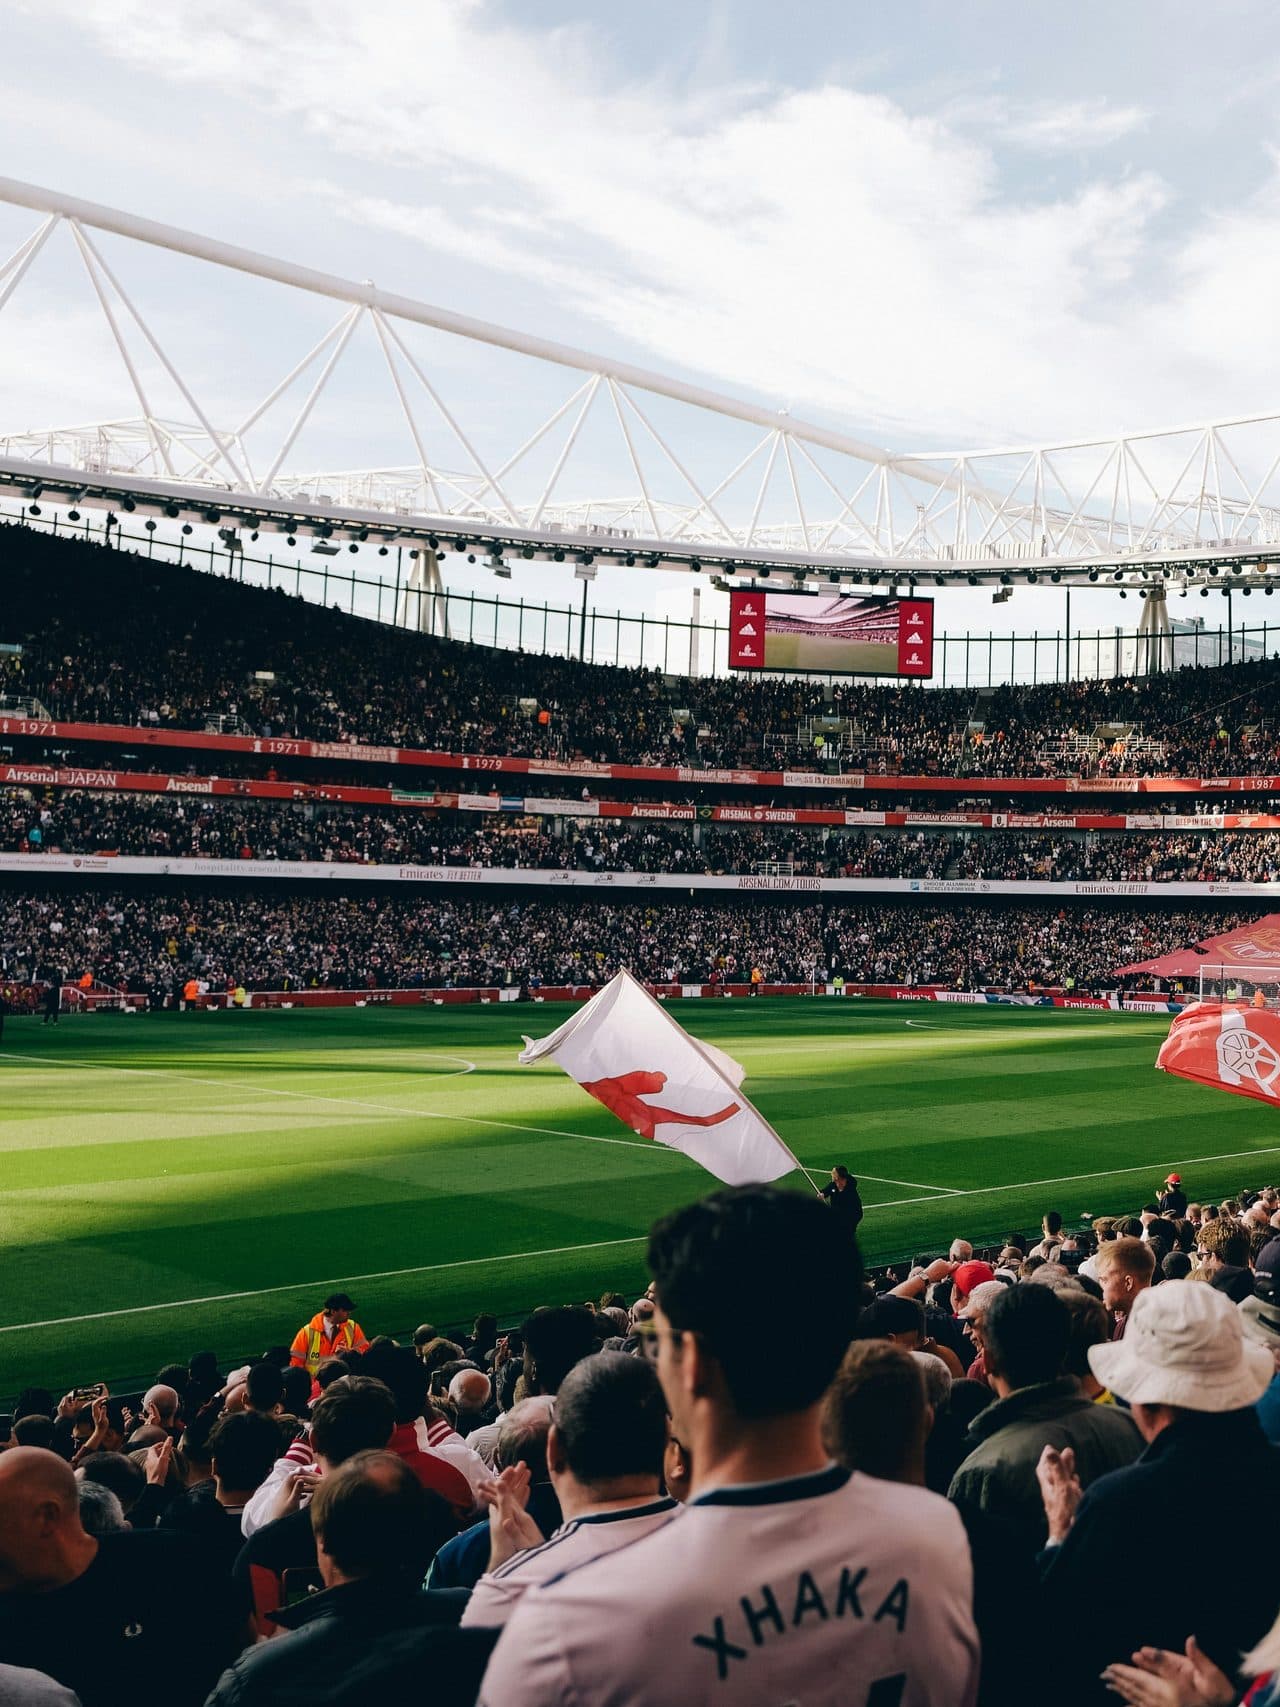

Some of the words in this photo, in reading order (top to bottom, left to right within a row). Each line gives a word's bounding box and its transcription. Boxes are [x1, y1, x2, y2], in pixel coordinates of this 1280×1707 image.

[20, 722, 57, 736] 1971
[268, 742, 300, 754] 1971
[475, 759, 502, 770] 1979
[6, 768, 59, 783] Arsenal
[67, 772, 117, 787] JAPAN
[166, 779, 213, 793] Arsenal
[1251, 780, 1274, 789] 1987
[631, 806, 694, 819] Arsenal.com
[719, 808, 752, 820] ARSENAL
[765, 810, 796, 821] SWEDEN
[1042, 816, 1076, 827] Arsenal
[399, 868, 444, 880] Emirates
[738, 877, 820, 889] ARSENAL.COM/TOURS
[1075, 884, 1114, 893] Emirates
[693, 1566, 909, 1680] XHAKA
